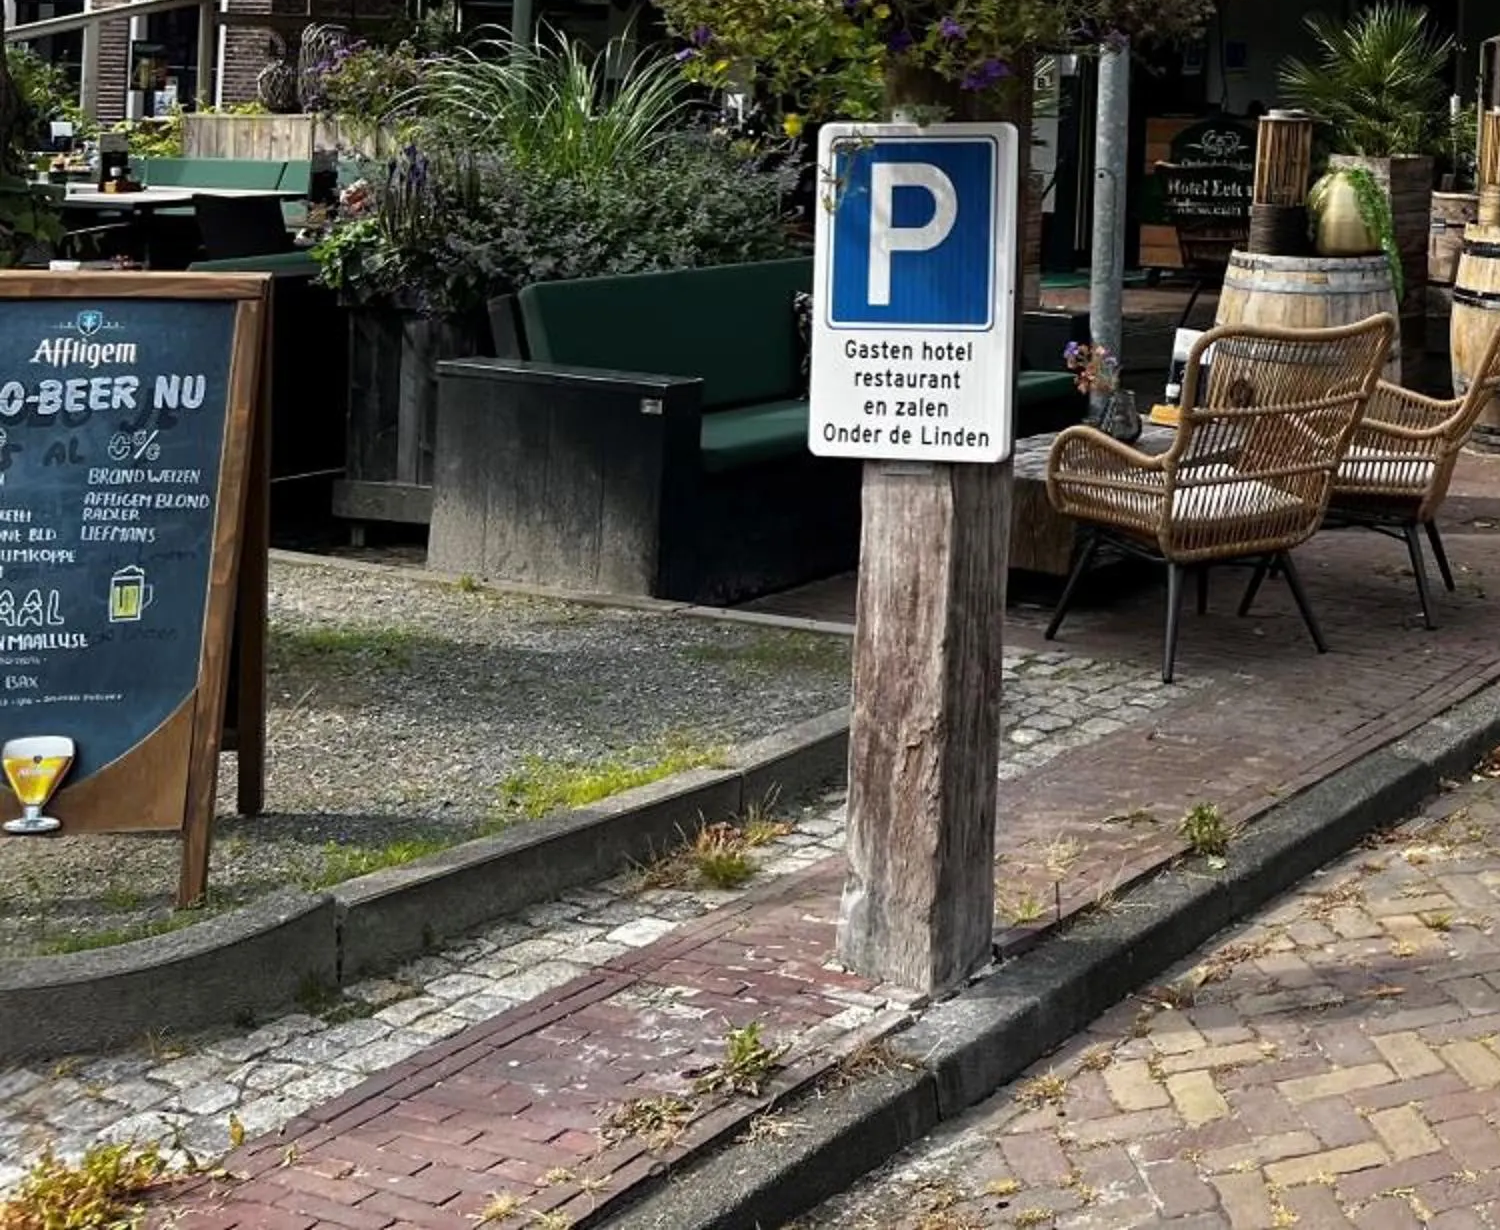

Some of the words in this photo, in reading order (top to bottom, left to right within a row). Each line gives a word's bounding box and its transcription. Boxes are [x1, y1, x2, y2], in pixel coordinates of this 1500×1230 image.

[867, 162, 958, 306] P
[30, 337, 137, 369] Affligem
[844, 339, 913, 361] Gasten
[921, 341, 973, 362] hotel
[853, 368, 961, 390] restaurant
[153, 374, 206, 410] NU
[863, 399, 887, 416] en
[895, 398, 949, 418] zalen
[823, 423, 883, 444] Onder
[889, 425, 912, 446] de
[921, 426, 990, 448] Linden
[88, 467, 145, 486] BRAND
[155, 493, 210, 509] BLOND
[82, 507, 141, 522] RADLER
[80, 524, 156, 543] LIEFMANS
